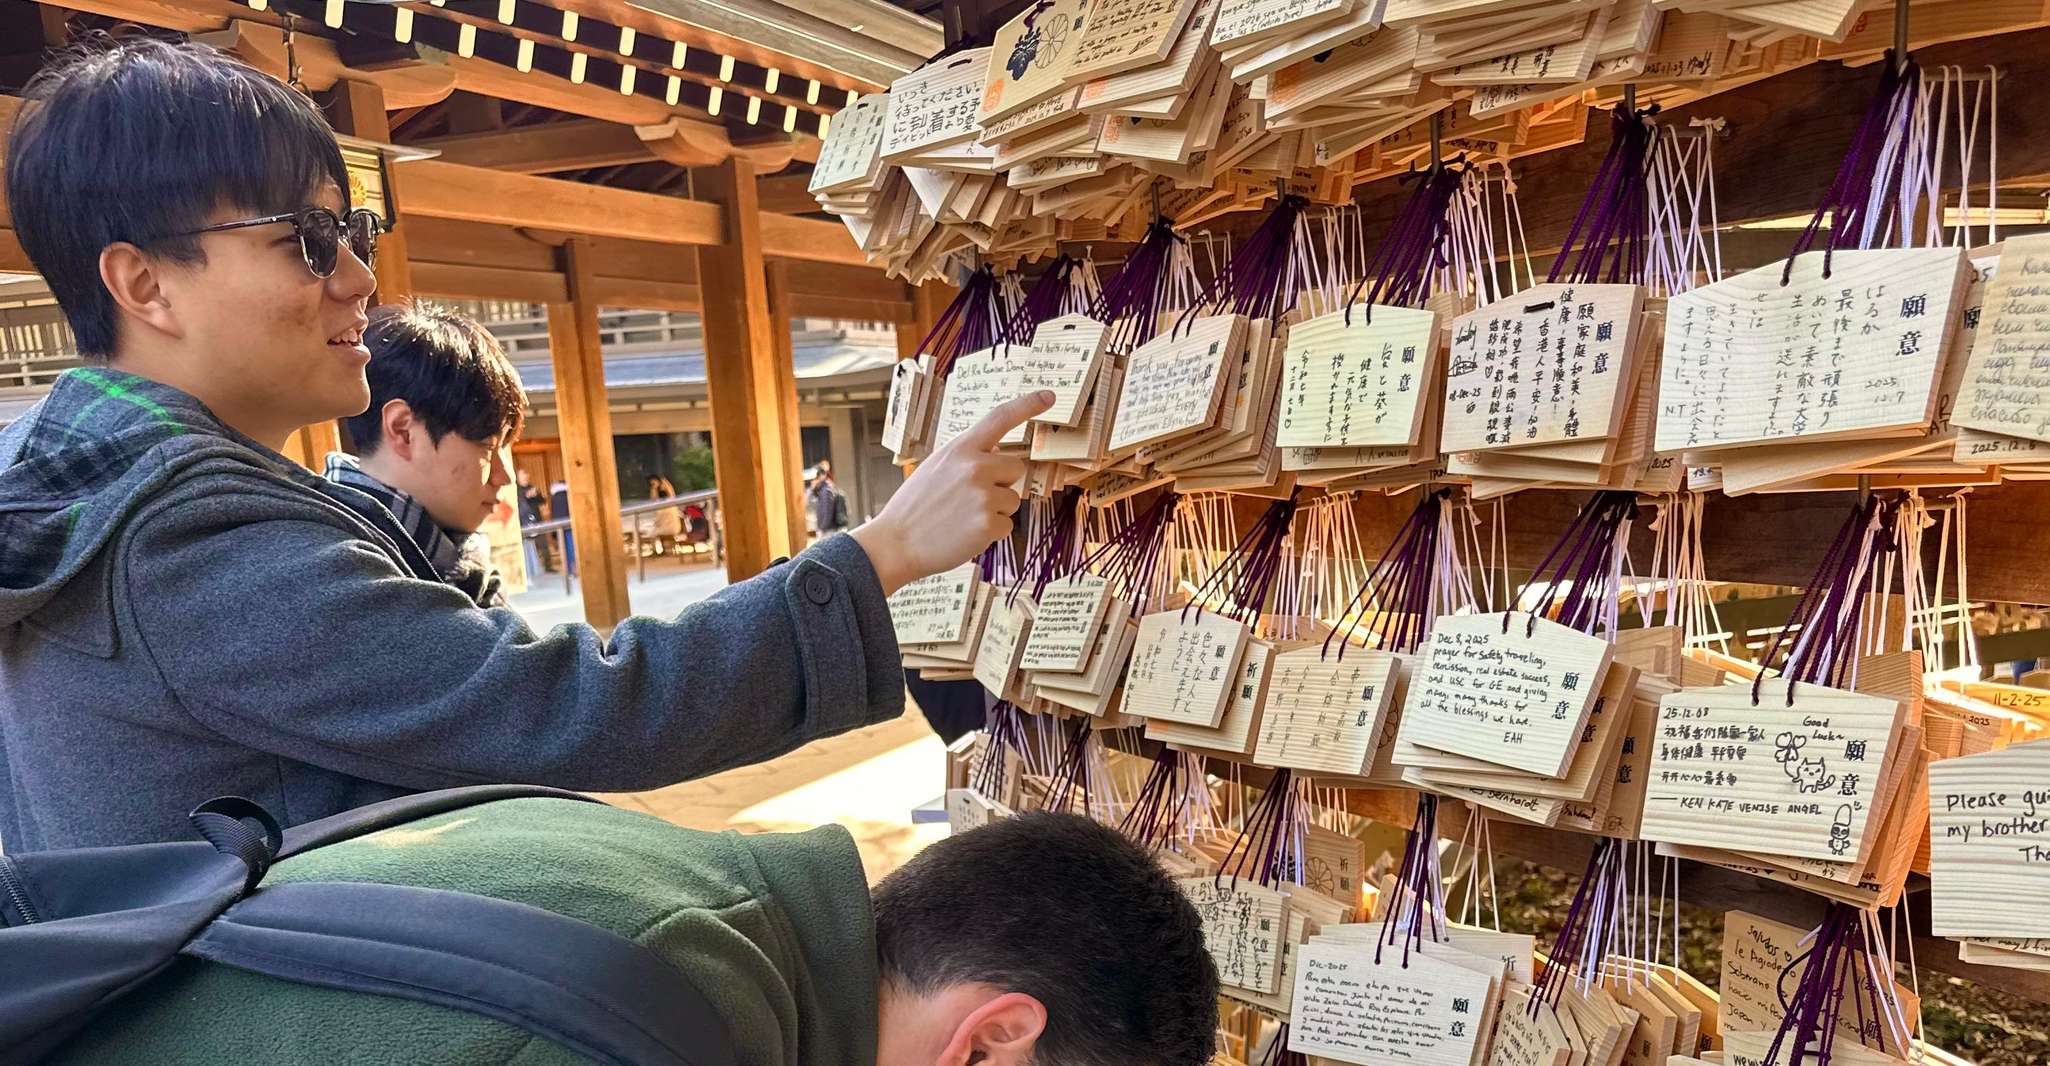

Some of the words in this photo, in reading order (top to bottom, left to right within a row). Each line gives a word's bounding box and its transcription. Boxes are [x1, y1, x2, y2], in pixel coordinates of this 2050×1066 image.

[1861, 286, 1888, 335] はるか
[1895, 293, 1928, 356] 願意
[1592, 320, 1613, 374] 願意
[1397, 345, 1416, 393] 願意
[1438, 633, 1453, 644] Dec
[1465, 634, 1490, 646] 2025
[1433, 648, 1460, 661] prayer
[1463, 646, 1478, 659] for
[1428, 675, 1443, 683] and
[1472, 678, 1485, 689] for
[1507, 685, 1521, 694] and
[1524, 688, 1548, 703] giving
[1551, 672, 1581, 720] 願意
[1420, 699, 1431, 708] all
[1437, 702, 1448, 713] the
[1454, 703, 1488, 721] blessings
[1454, 693, 1476, 708] many
[1479, 695, 1508, 709] thanks
[1514, 701, 1528, 712] for
[1802, 715, 1830, 728] Good
[1503, 731, 1524, 744] EAH
[1837, 739, 1868, 796] 願意
[1680, 796, 1704, 809] KEN
[1707, 798, 1735, 814] KATE
[1788, 804, 1822, 815] ANGEL
[1947, 825, 1971, 842] my
[1982, 816, 2049, 838] brother
